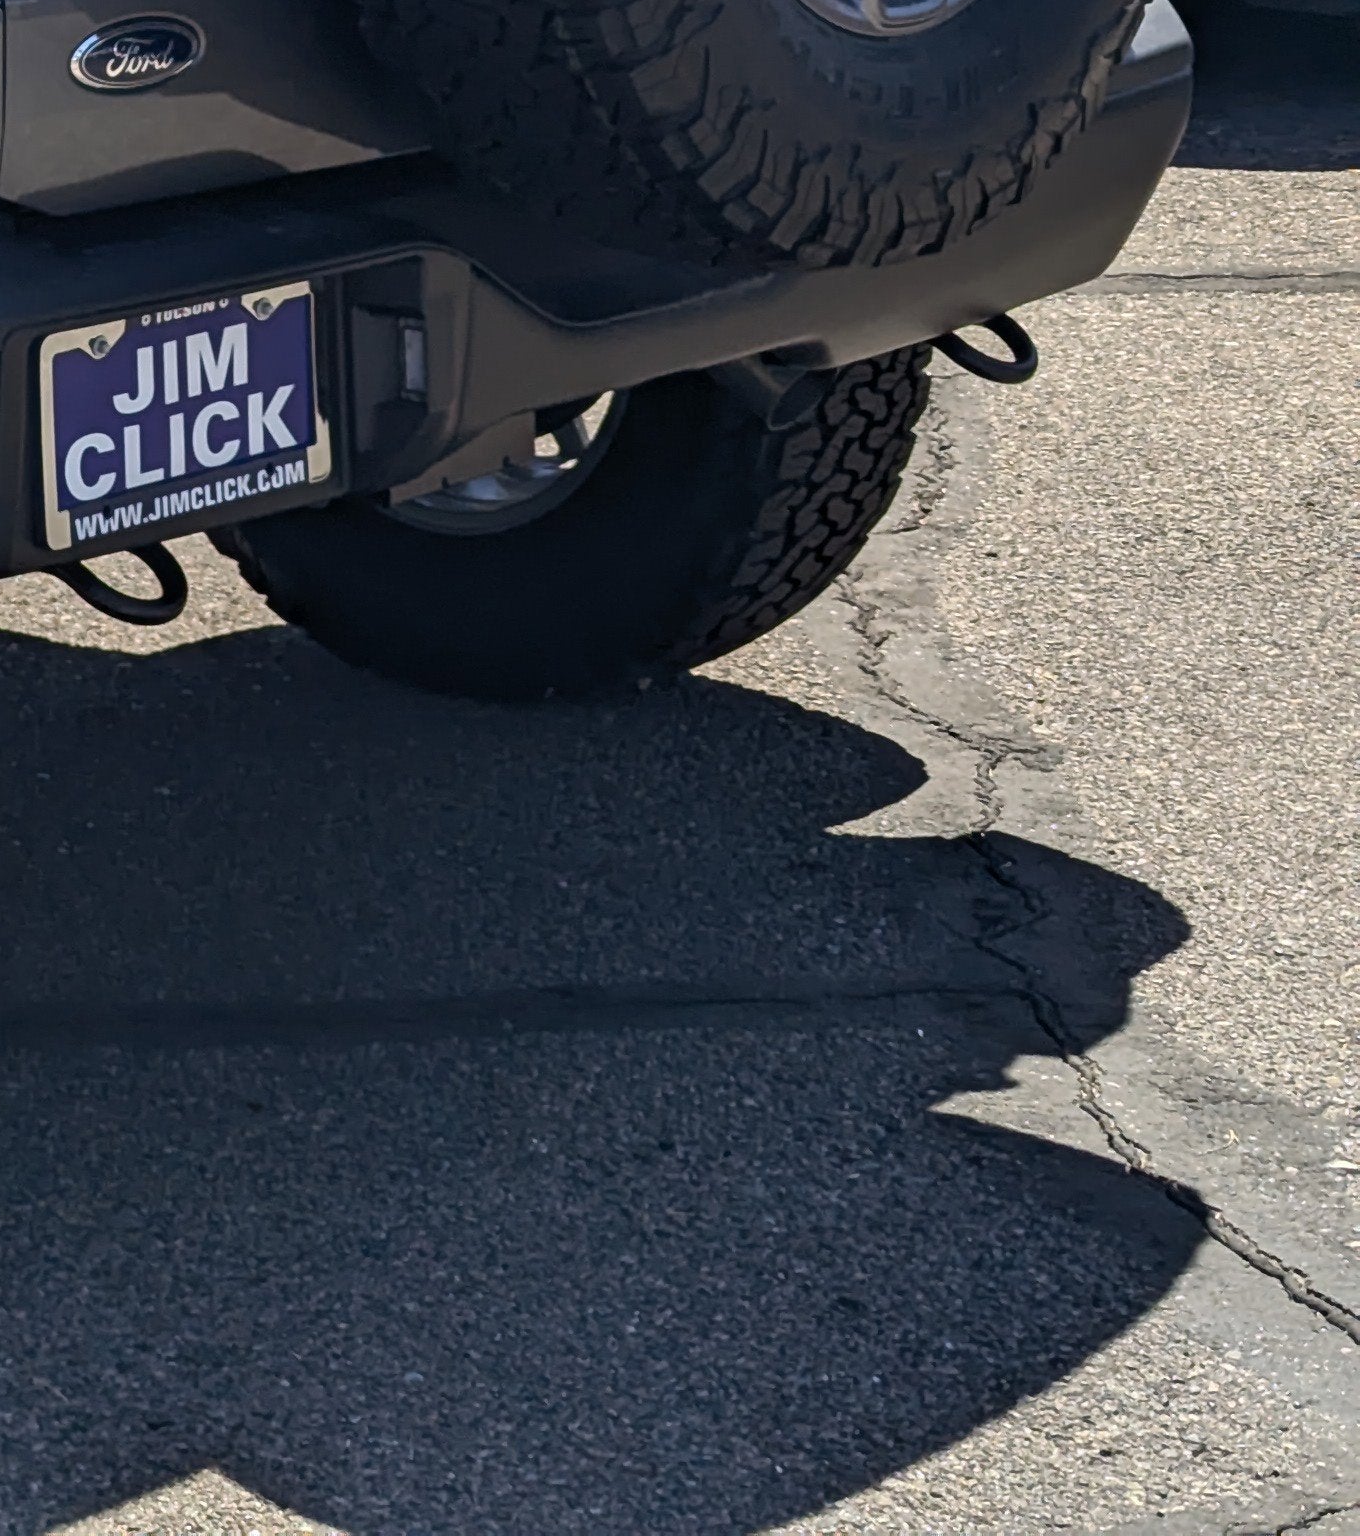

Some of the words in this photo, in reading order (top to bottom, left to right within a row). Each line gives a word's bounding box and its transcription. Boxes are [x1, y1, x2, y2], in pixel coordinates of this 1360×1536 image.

[105, 36, 176, 79] Ford
[112, 322, 249, 415] JIM
[64, 383, 298, 502] CLICK
[74, 460, 306, 541] WWW.JIMCLICK.COM
